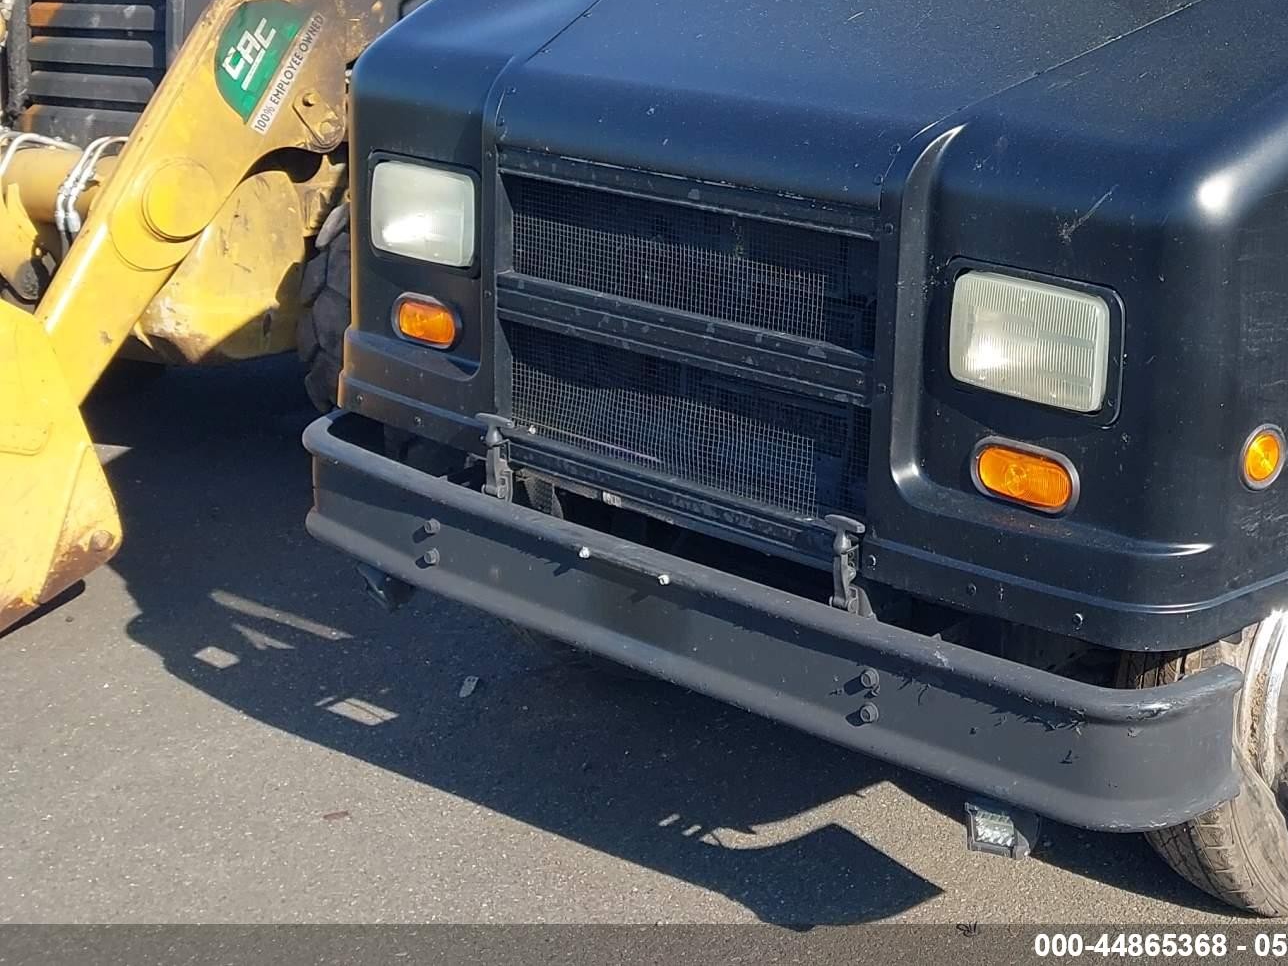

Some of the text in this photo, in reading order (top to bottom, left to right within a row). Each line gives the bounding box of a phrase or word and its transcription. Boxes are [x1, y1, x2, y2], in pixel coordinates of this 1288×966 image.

[254, 15, 324, 132] 100% EMPLOYEE OWNED
